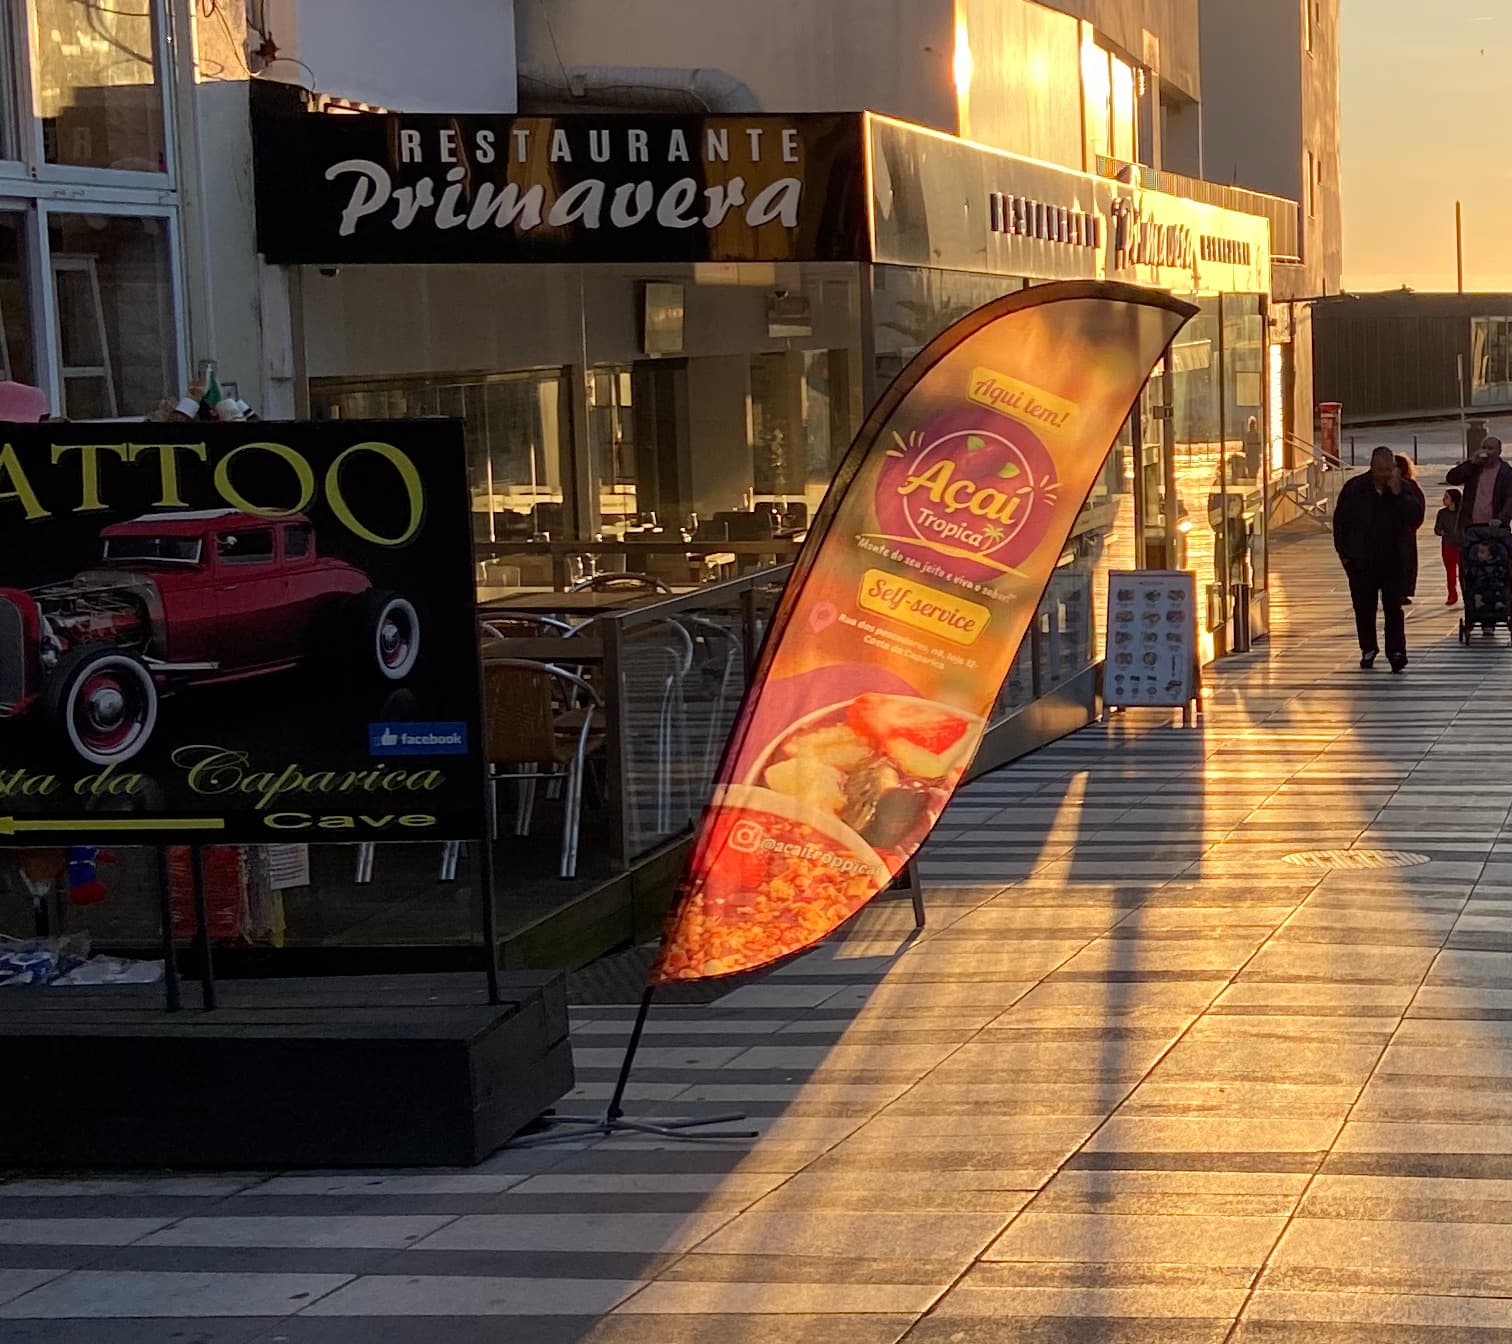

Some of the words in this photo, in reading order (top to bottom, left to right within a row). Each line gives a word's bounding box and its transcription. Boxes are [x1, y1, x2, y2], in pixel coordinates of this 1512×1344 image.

[401, 128, 799, 164] RESTAURANTE
[325, 159, 802, 237] Primavera
[974, 376, 1024, 410] Aqui
[1023, 397, 1071, 429] tem!
[897, 459, 1033, 525] Açaí
[868, 578, 977, 633] Self-service
[400, 731, 463, 747] facebook
[73, 760, 145, 796] da
[170, 744, 446, 810] Caparica
[263, 812, 438, 830] Cave
